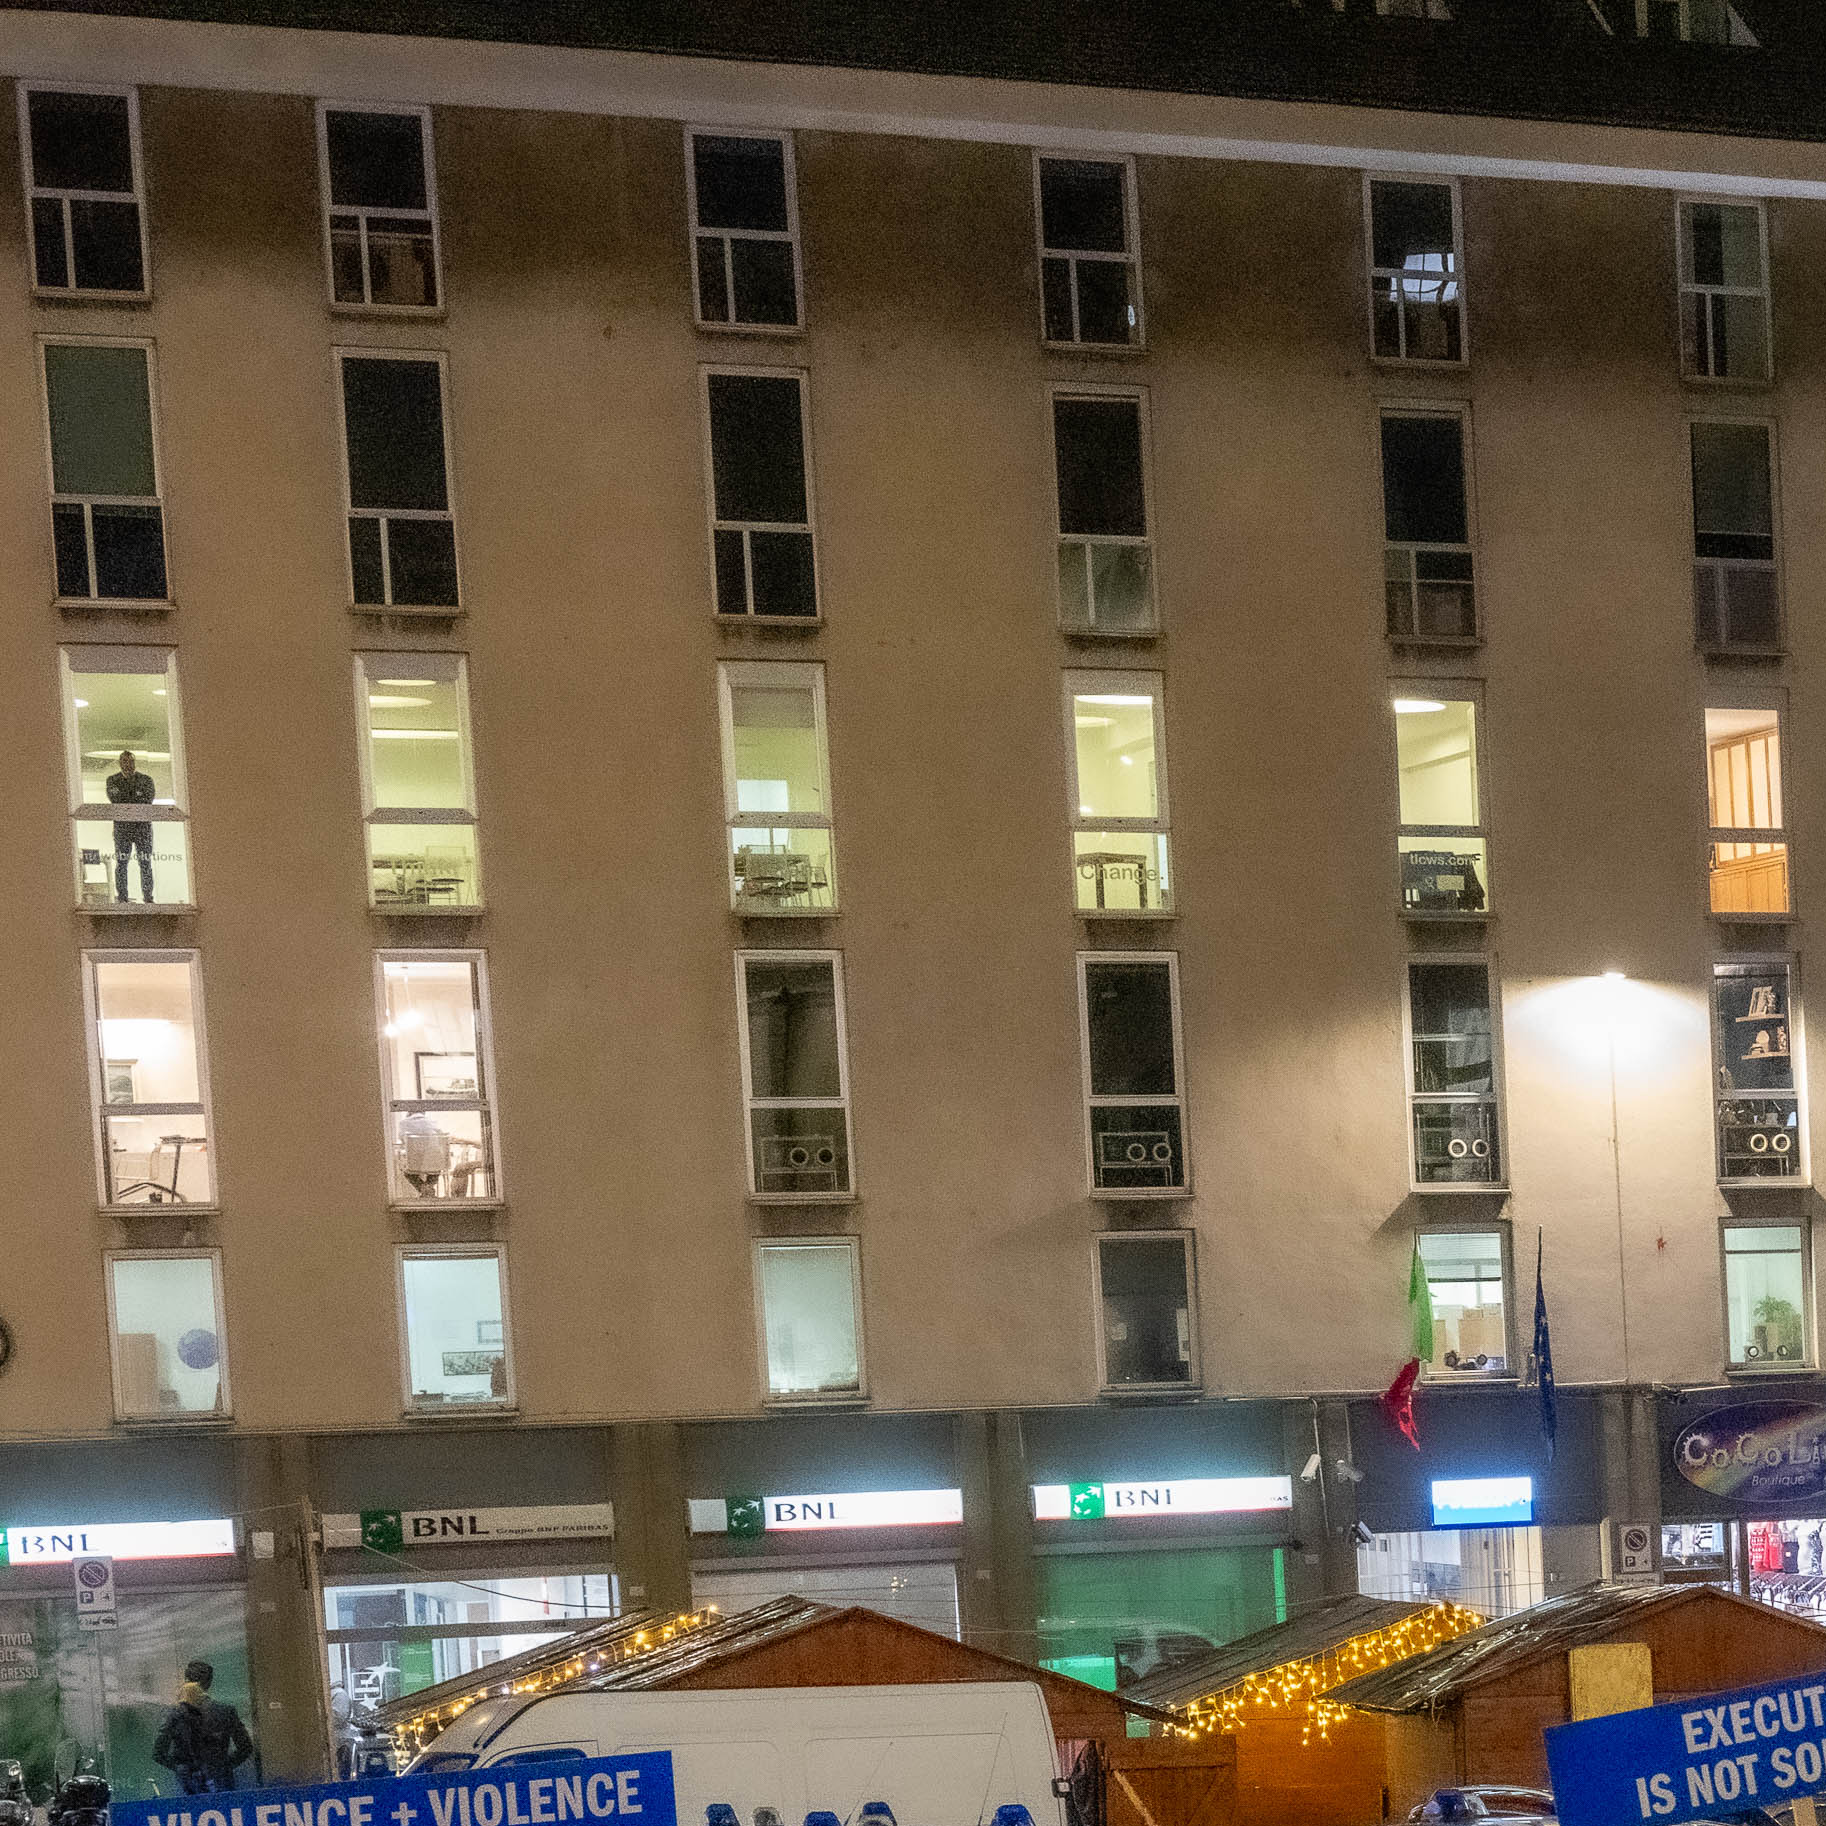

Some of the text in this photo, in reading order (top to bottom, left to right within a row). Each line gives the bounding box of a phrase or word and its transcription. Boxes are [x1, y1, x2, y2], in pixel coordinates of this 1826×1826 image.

[1751, 1474, 1806, 1487] Boutique
[774, 1502, 846, 1523] BNL
[412, 1515, 489, 1537] BNL
[1636, 1773, 1677, 1818] IS
[1686, 1753, 1760, 1807] NOT
[391, 1802, 417, 1826] +
